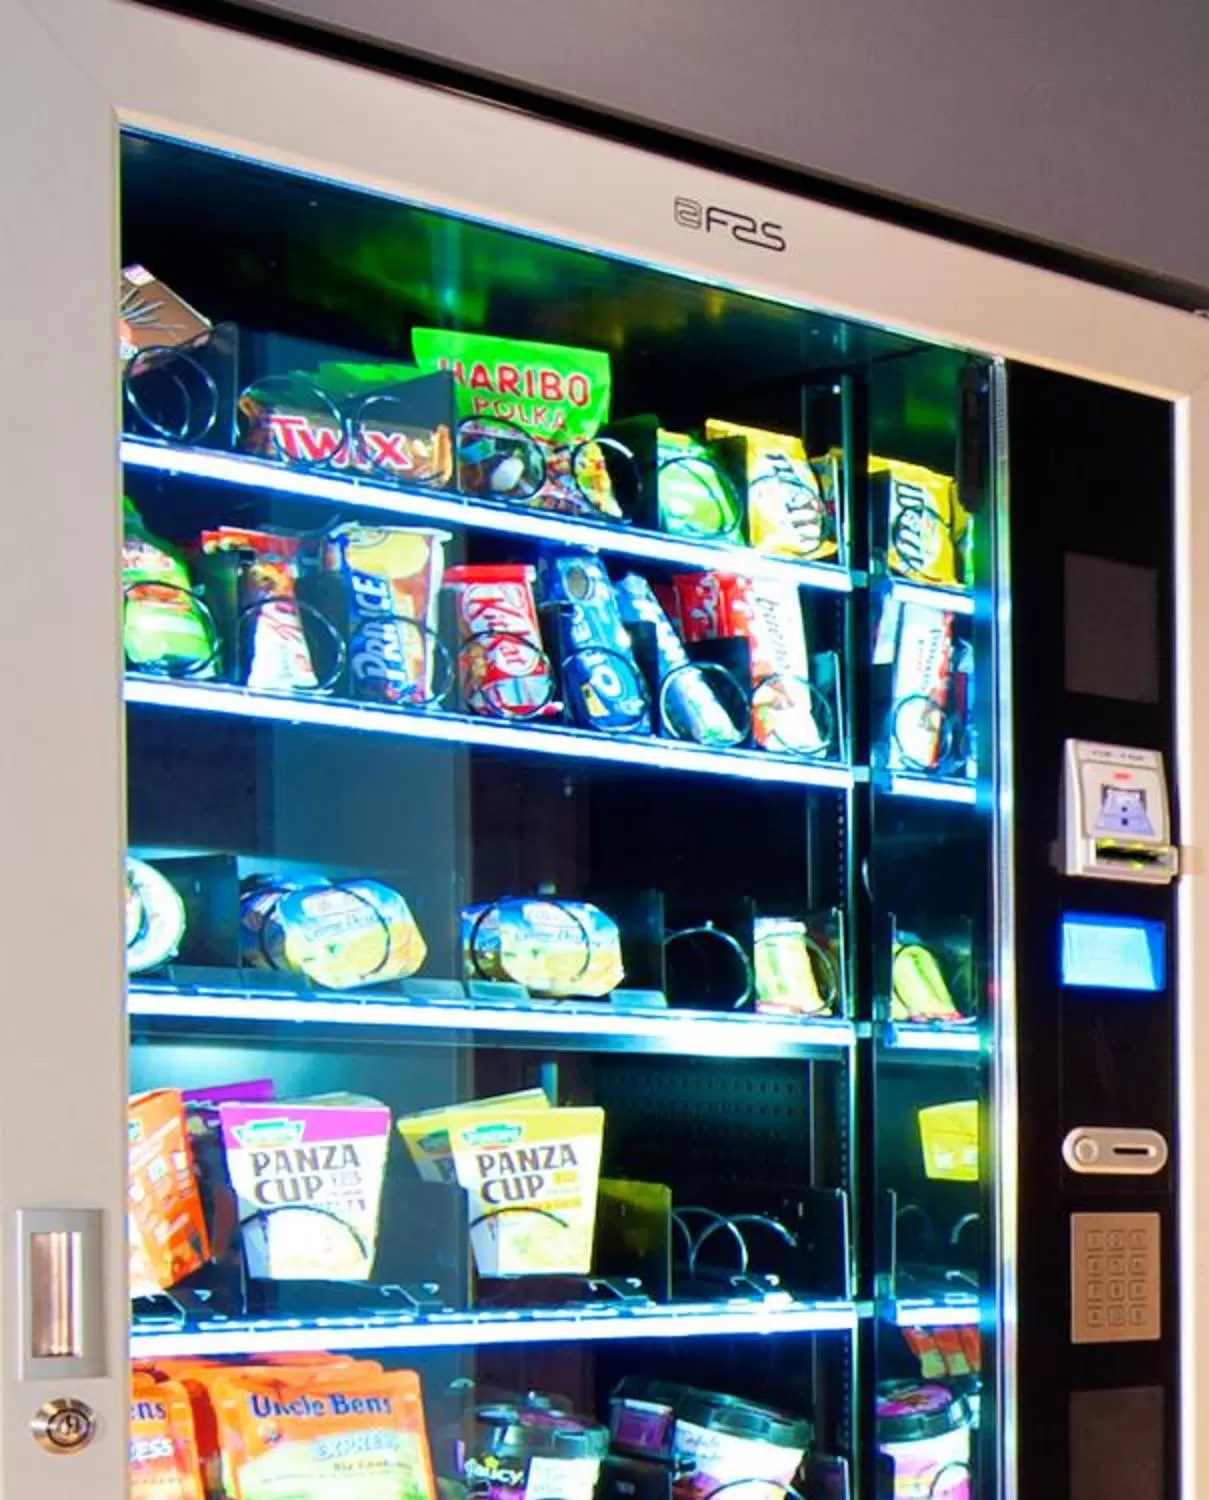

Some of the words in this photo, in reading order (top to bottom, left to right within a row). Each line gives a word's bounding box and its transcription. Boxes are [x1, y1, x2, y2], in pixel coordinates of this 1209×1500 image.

[437, 357, 591, 408] HARIBO
[248, 1142, 361, 1178] PANZA
[475, 1142, 579, 1179] PANZA
[253, 1174, 325, 1206] CUP
[480, 1173, 545, 1205] CUP
